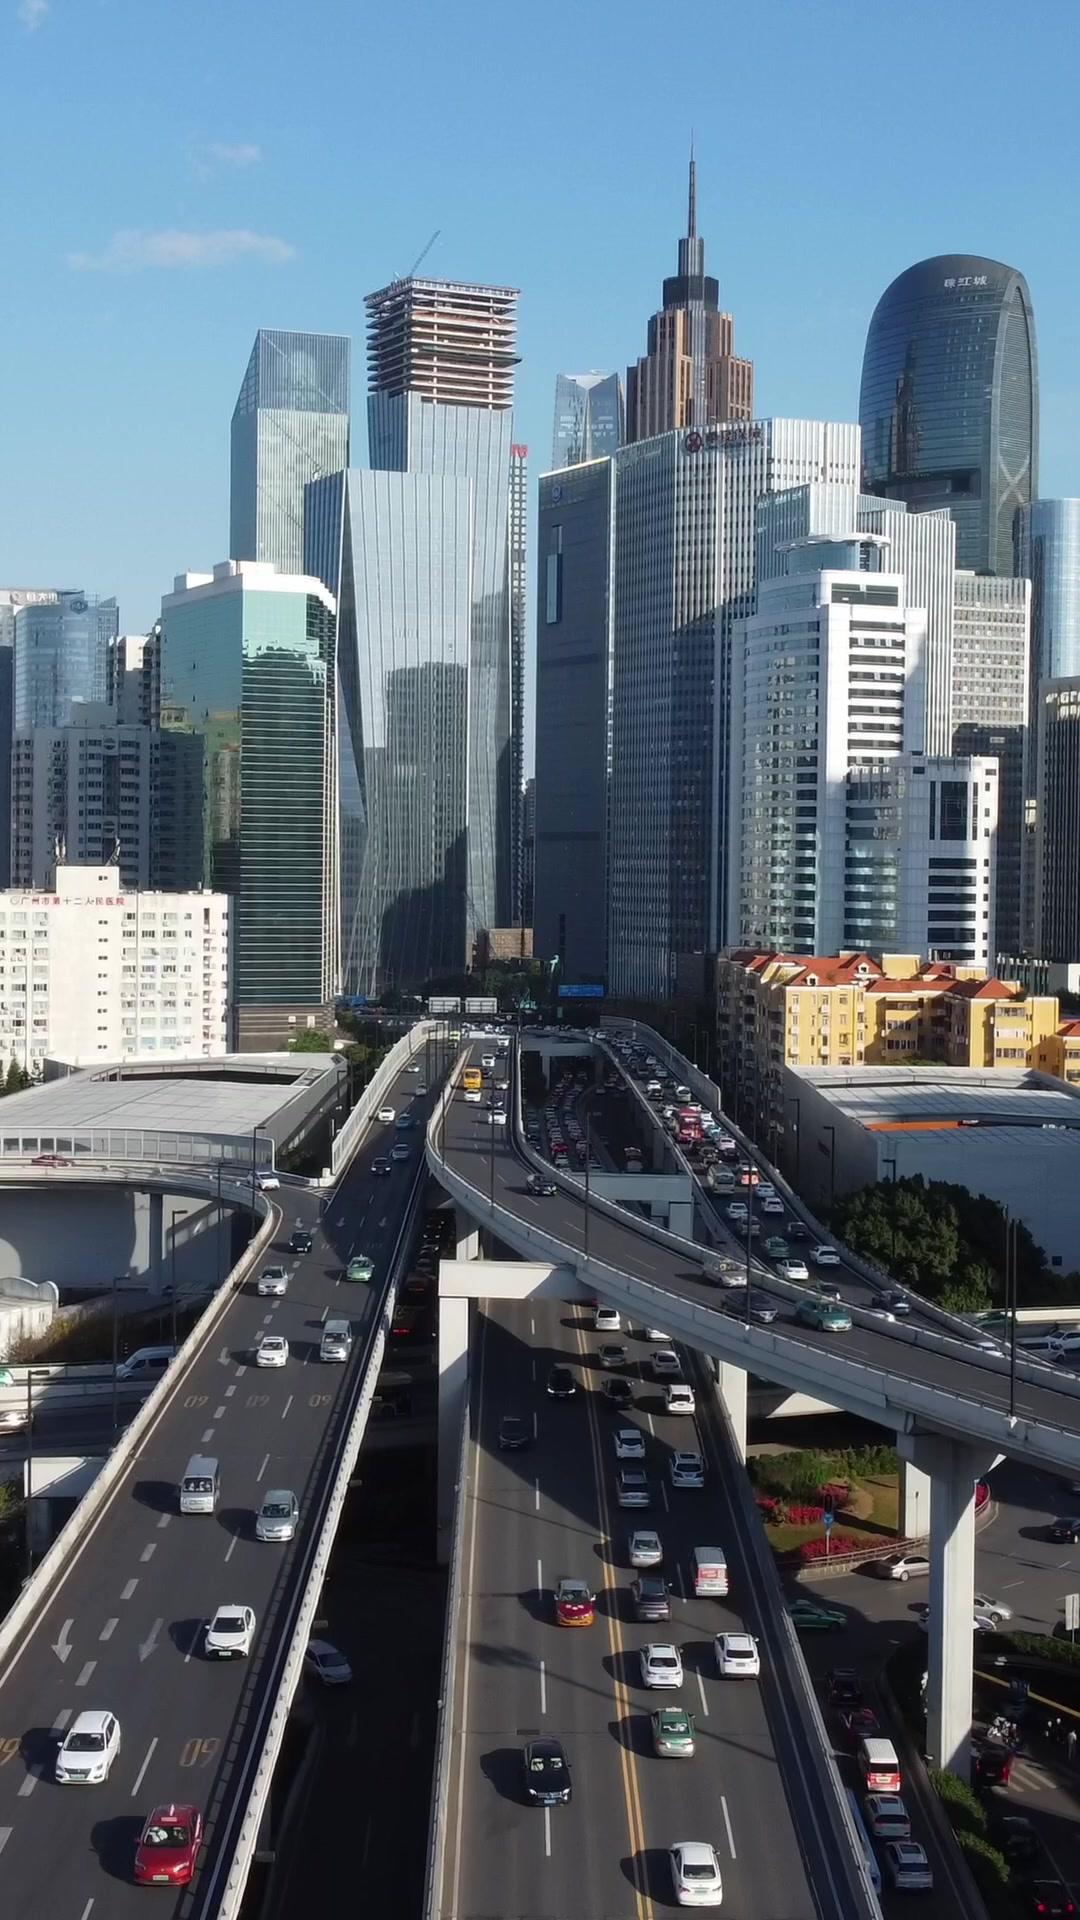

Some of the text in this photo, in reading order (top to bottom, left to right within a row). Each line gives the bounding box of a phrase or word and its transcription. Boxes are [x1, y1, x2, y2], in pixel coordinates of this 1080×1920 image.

[944, 275, 988, 289] 珠江城
[20, 896, 126, 906] 广州市第十二人民医院
